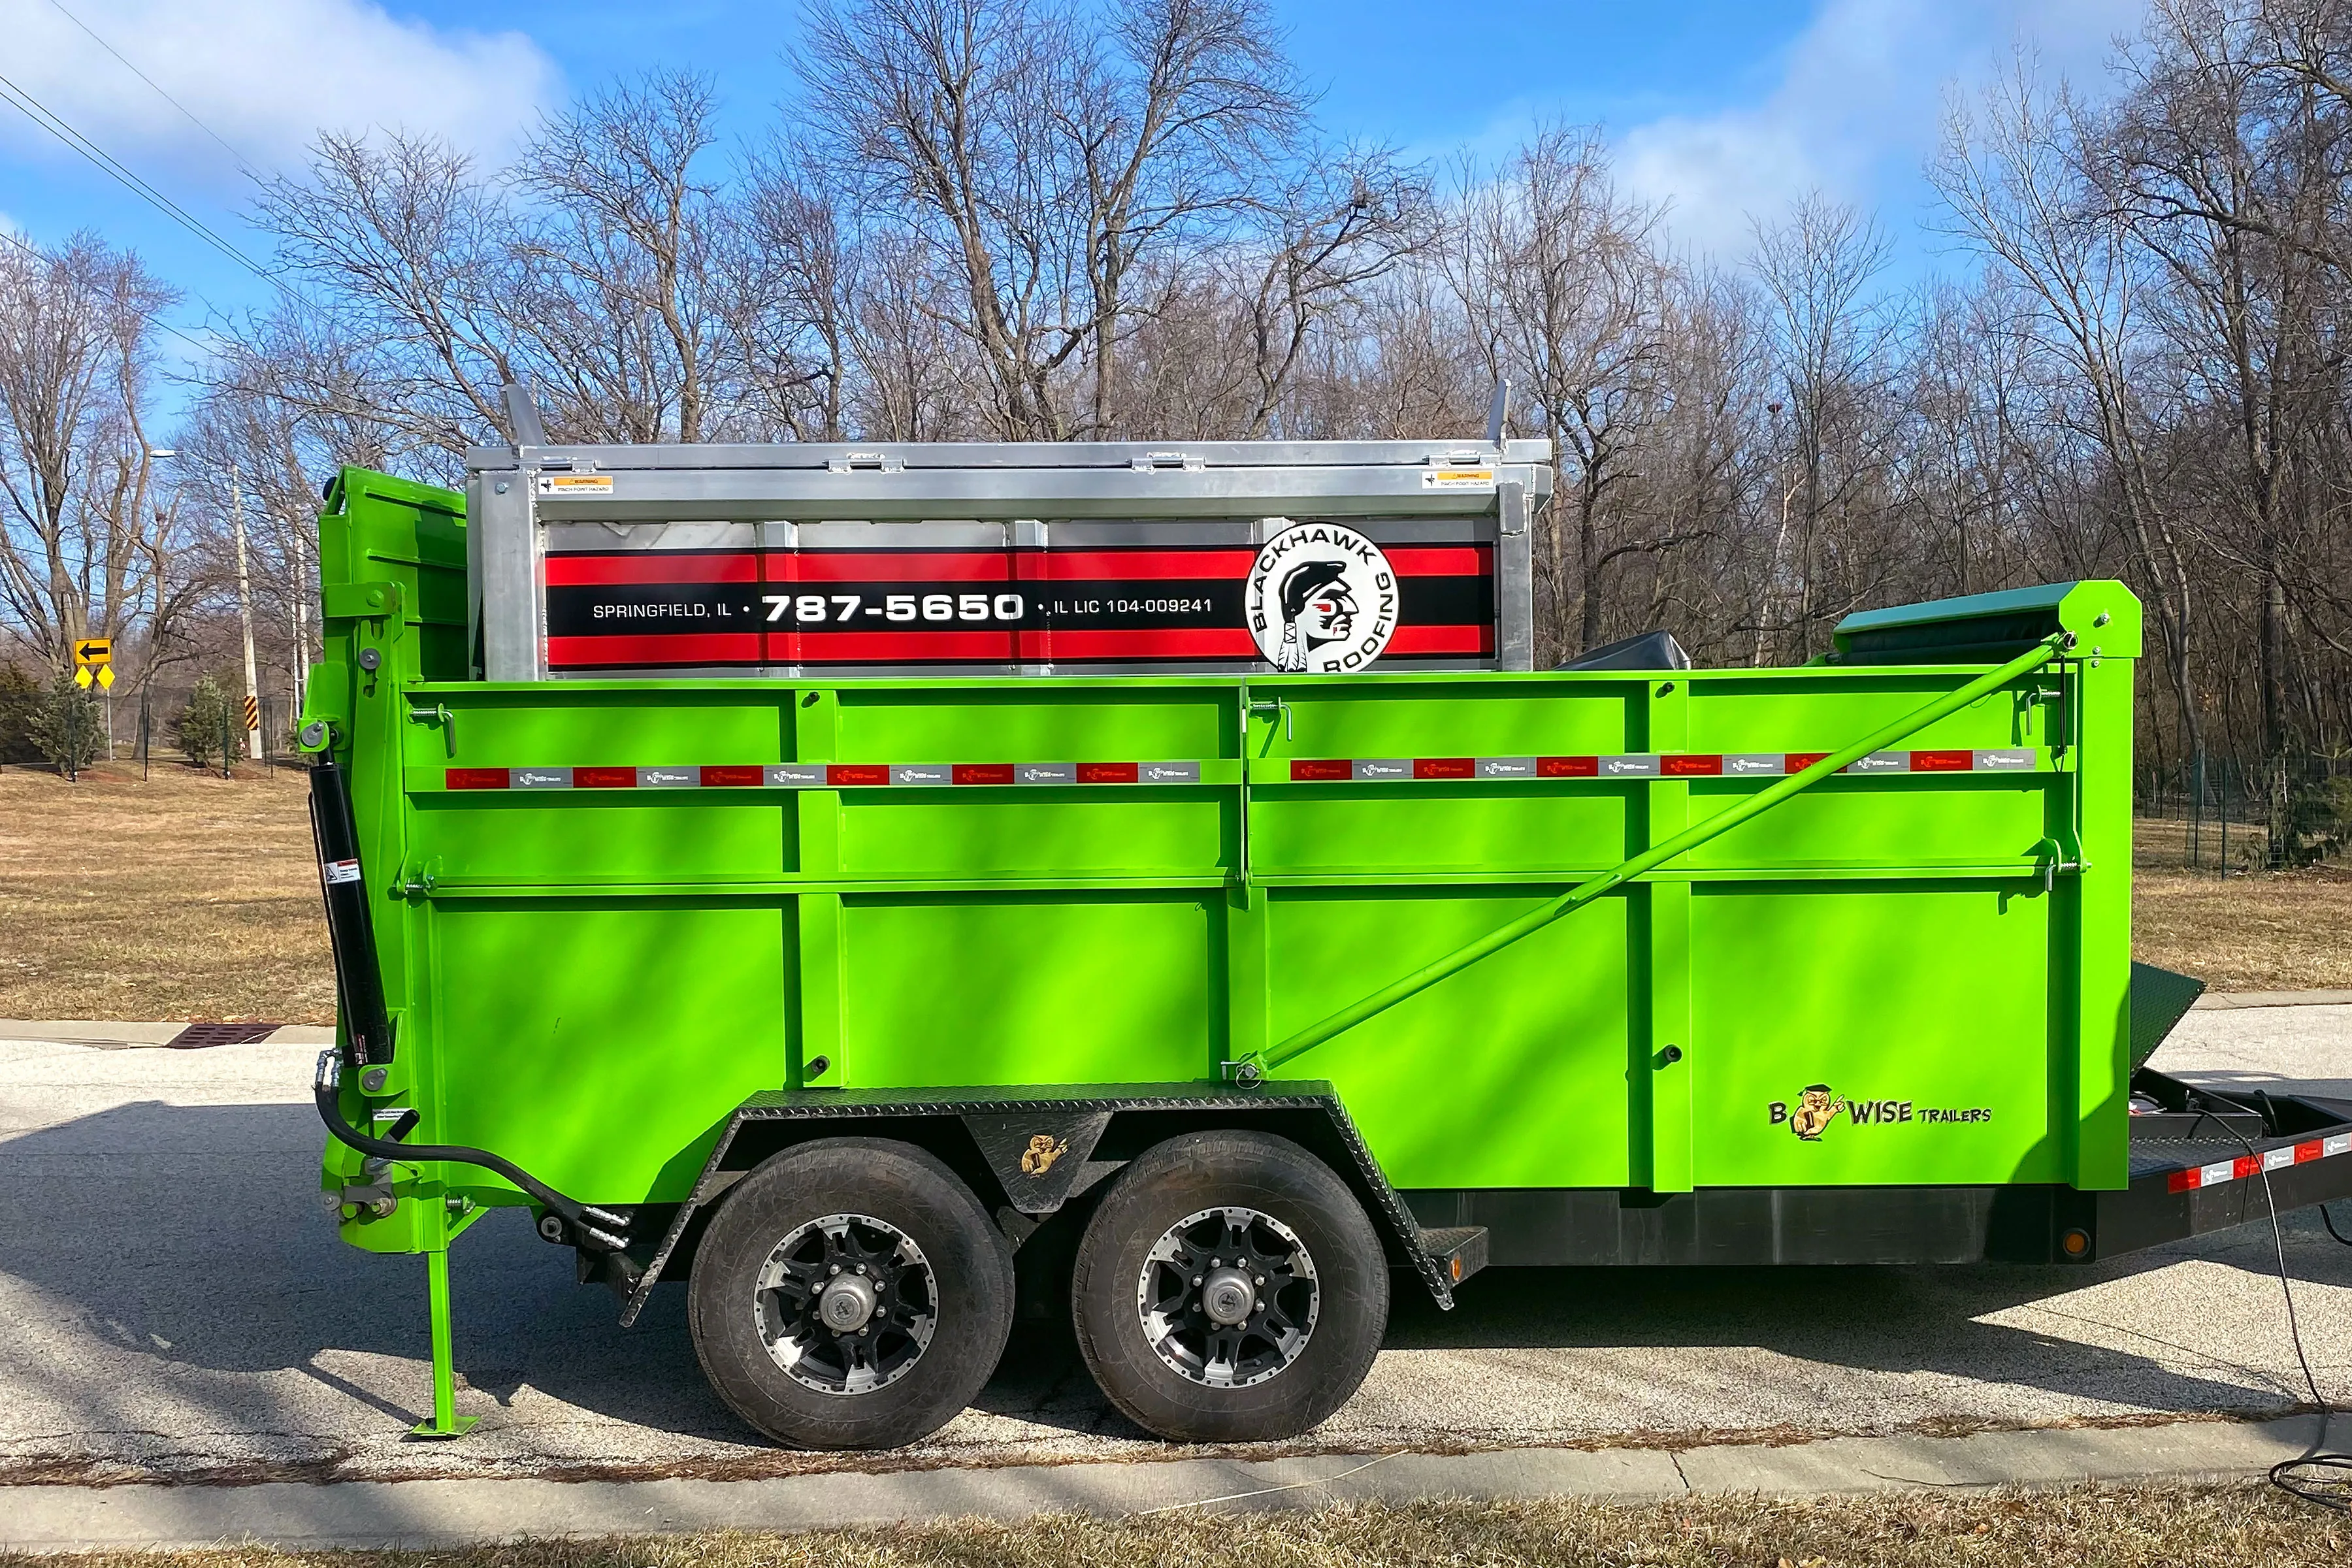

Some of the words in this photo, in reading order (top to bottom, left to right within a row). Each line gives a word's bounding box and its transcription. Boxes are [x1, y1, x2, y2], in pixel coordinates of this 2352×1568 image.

[593, 603, 710, 618] SPRINGFIELD,
[717, 602, 732, 616] IL
[762, 594, 1024, 622] 787-5650
[1054, 600, 1069, 613] IL
[1074, 600, 1100, 613] LIC
[1107, 598, 1212, 613] 104-009241
[1250, 528, 1377, 633] BLACKHAWK
[1323, 572, 1387, 672] ROOFING
[1846, 1099, 1913, 1126] WISE
[1918, 1108, 1993, 1124] TRAILERS
